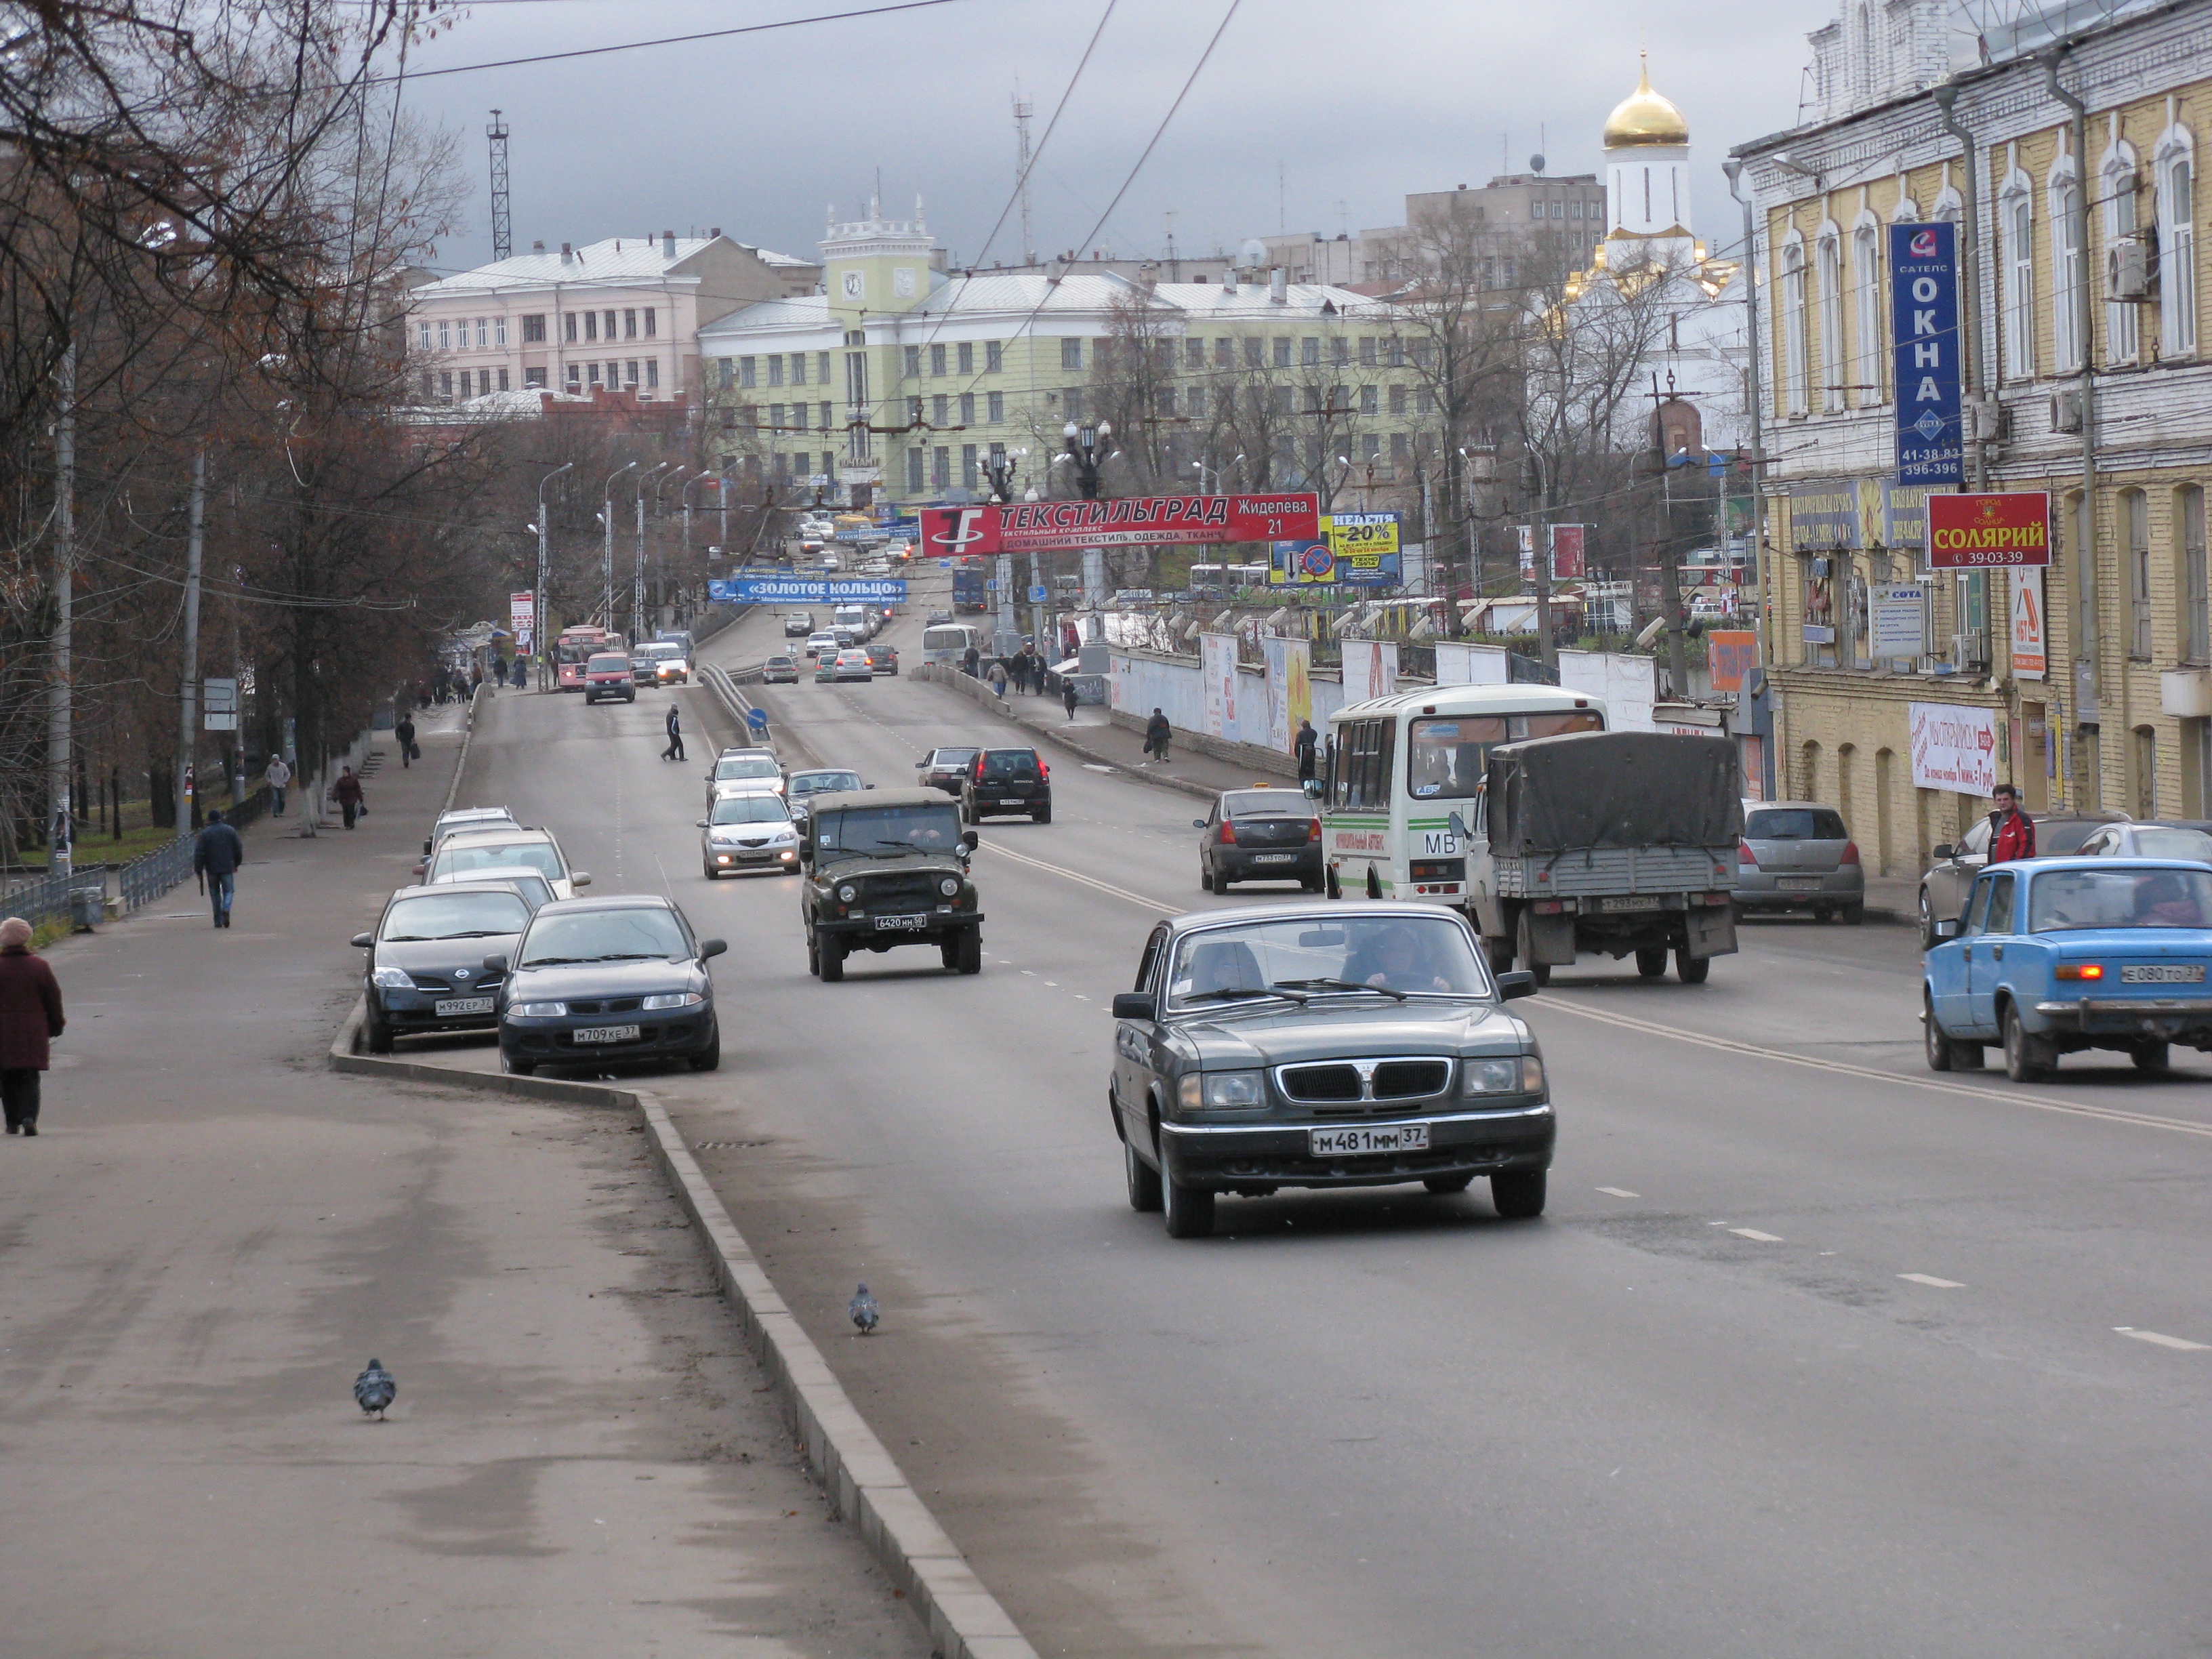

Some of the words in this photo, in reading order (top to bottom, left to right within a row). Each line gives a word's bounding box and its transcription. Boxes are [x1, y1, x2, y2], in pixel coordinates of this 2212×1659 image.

[1912, 276, 1942, 402] ОКНА
[1902, 447, 1959, 461] 41-38-83
[1905, 463, 1958, 475] 396-396
[1975, 498, 2002, 507] ГОРОД
[1000, 497, 1229, 530] ТЕКСТИЛЬГРАД
[1333, 514, 1395, 526] НЕДЕЛЯ
[1973, 517, 2006, 526] СОЛНЦА
[1000, 529, 1057, 537] ТЕКСТИЛЬНЫЙ
[1059, 526, 1103, 534] КОМПЛЕКС
[1267, 518, 1282, 535] 21
[1134, 532, 1183, 541] ОДЕЖДА,
[1933, 520, 2045, 550] СОЛЯРИЙ
[1968, 551, 2024, 563] 39-03-39
[747, 583, 826, 594] «ЗОЛОТОЕ
[1891, 590, 1922, 599] СОТА
[439, 1001, 478, 1011] М992ЕР
[577, 1029, 621, 1041] М709КЕ
[624, 1025, 636, 1035] 37
[1319, 1131, 1399, 1151] М481ММ
[1402, 1128, 1422, 1143] 37
